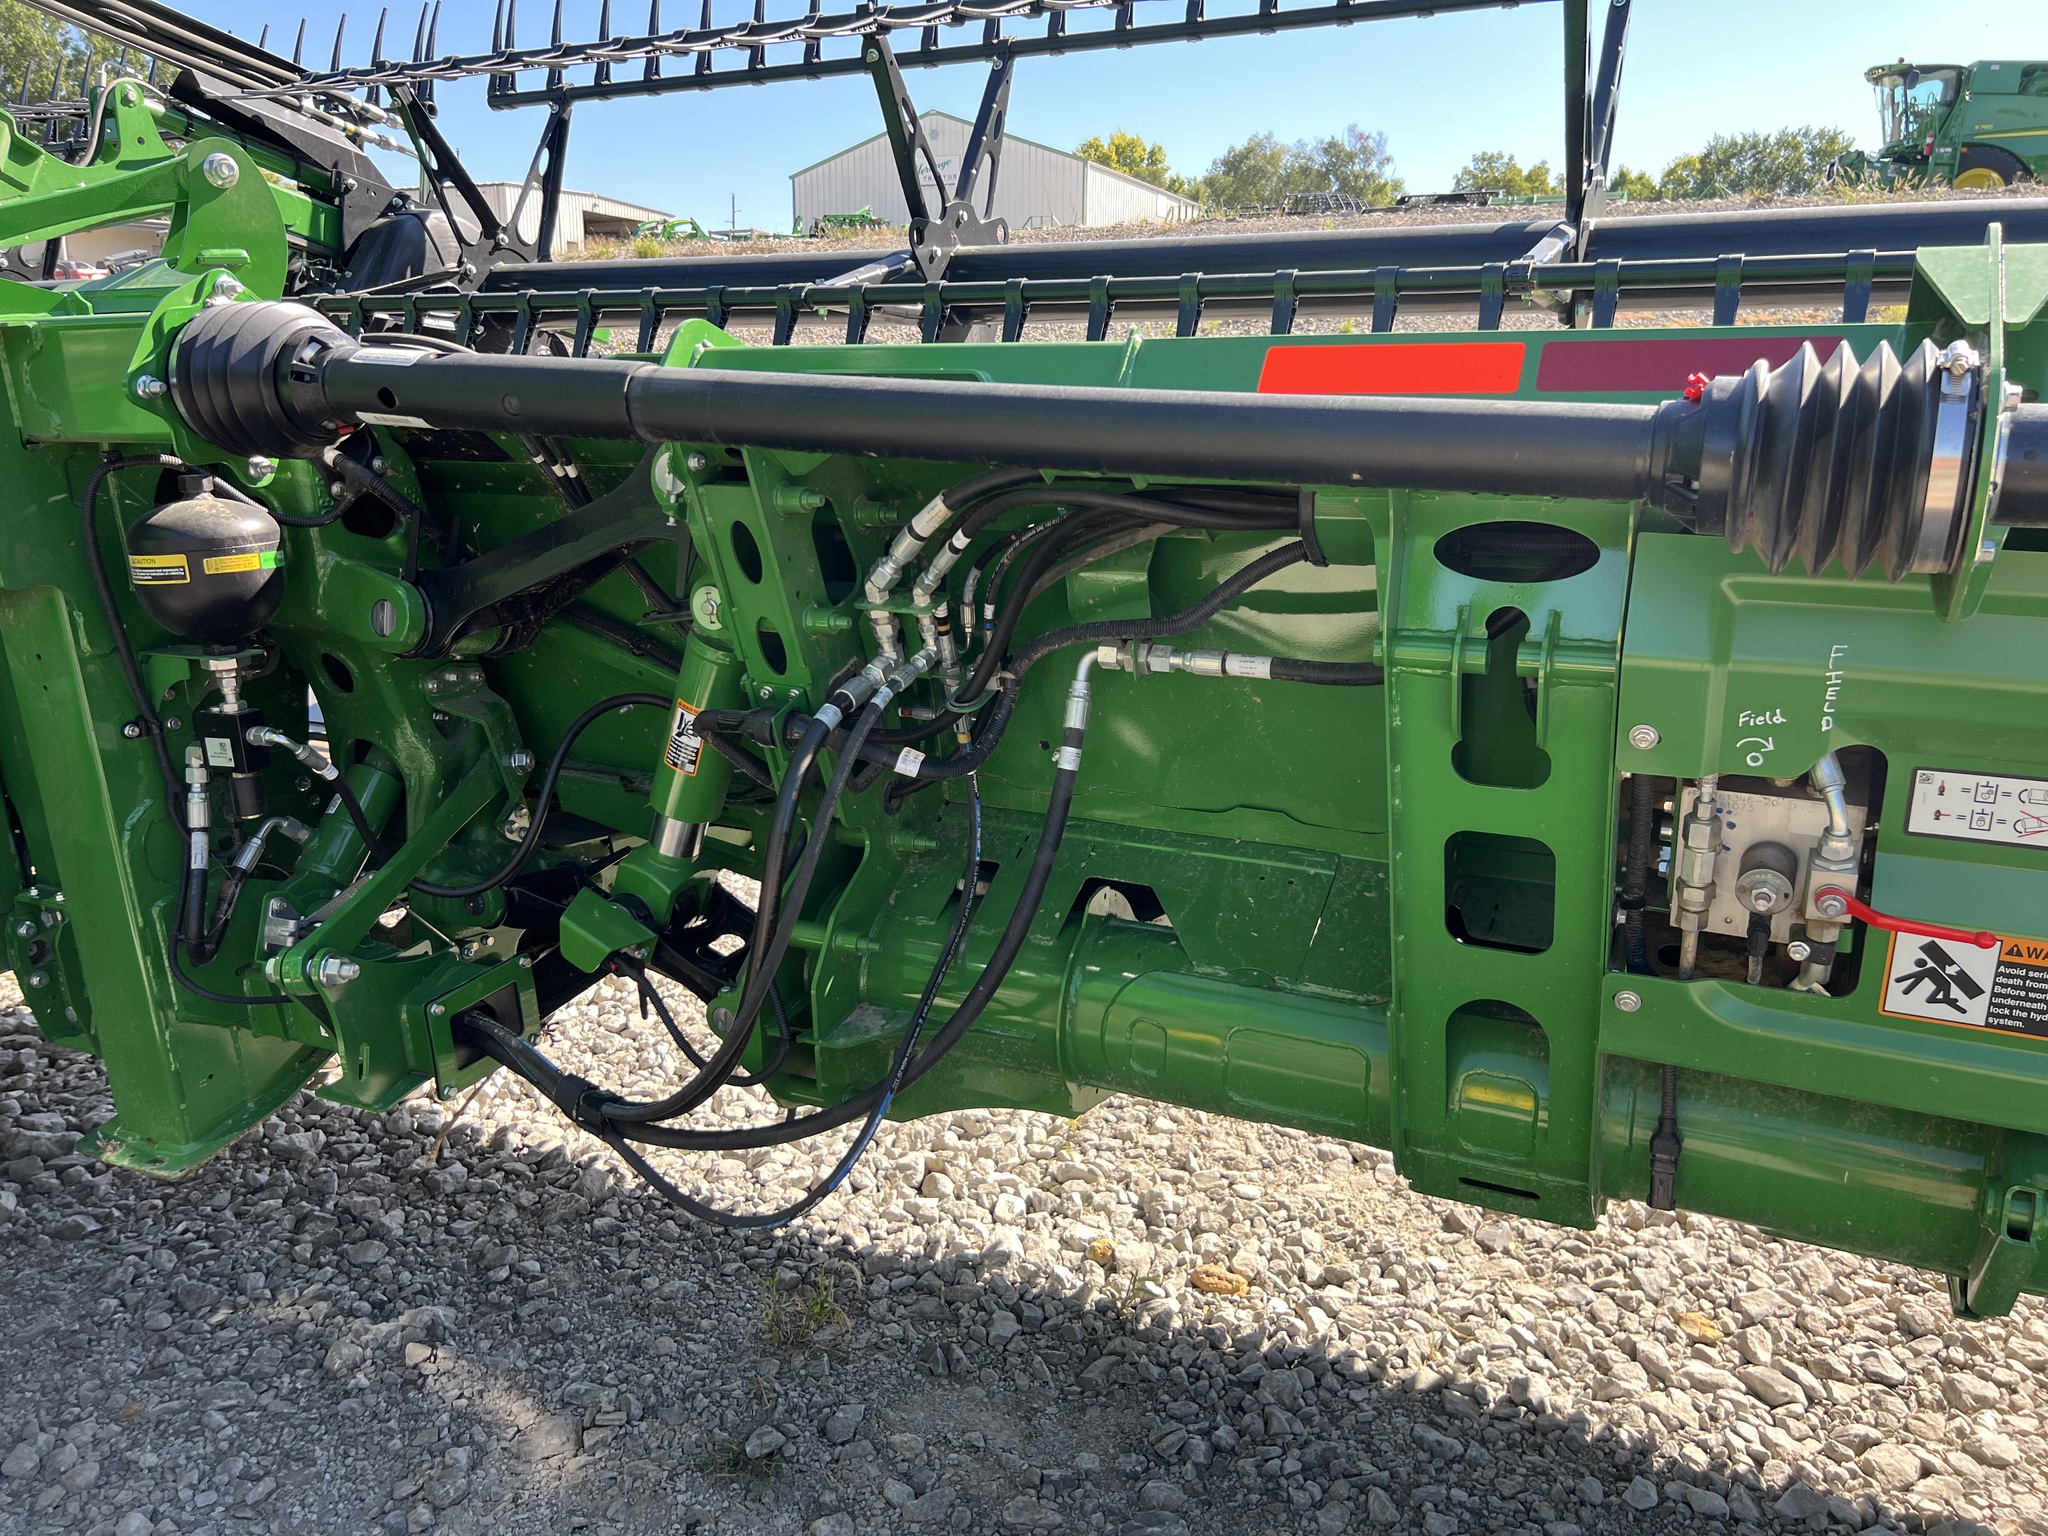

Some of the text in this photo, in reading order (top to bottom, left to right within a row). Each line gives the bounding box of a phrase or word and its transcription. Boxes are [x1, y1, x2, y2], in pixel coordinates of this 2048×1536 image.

[1821, 645, 1848, 732] FIELD
[1739, 708, 1786, 727] Field
[1998, 965, 2048, 979] Avoid seri
[1996, 976, 2048, 990] death from
[1994, 986, 2026, 997] Before
[1992, 996, 2047, 1010] underneath
[1990, 1006, 2010, 1015] lock
[2013, 1009, 2028, 1018] the
[1988, 1016, 2025, 1028] system.
